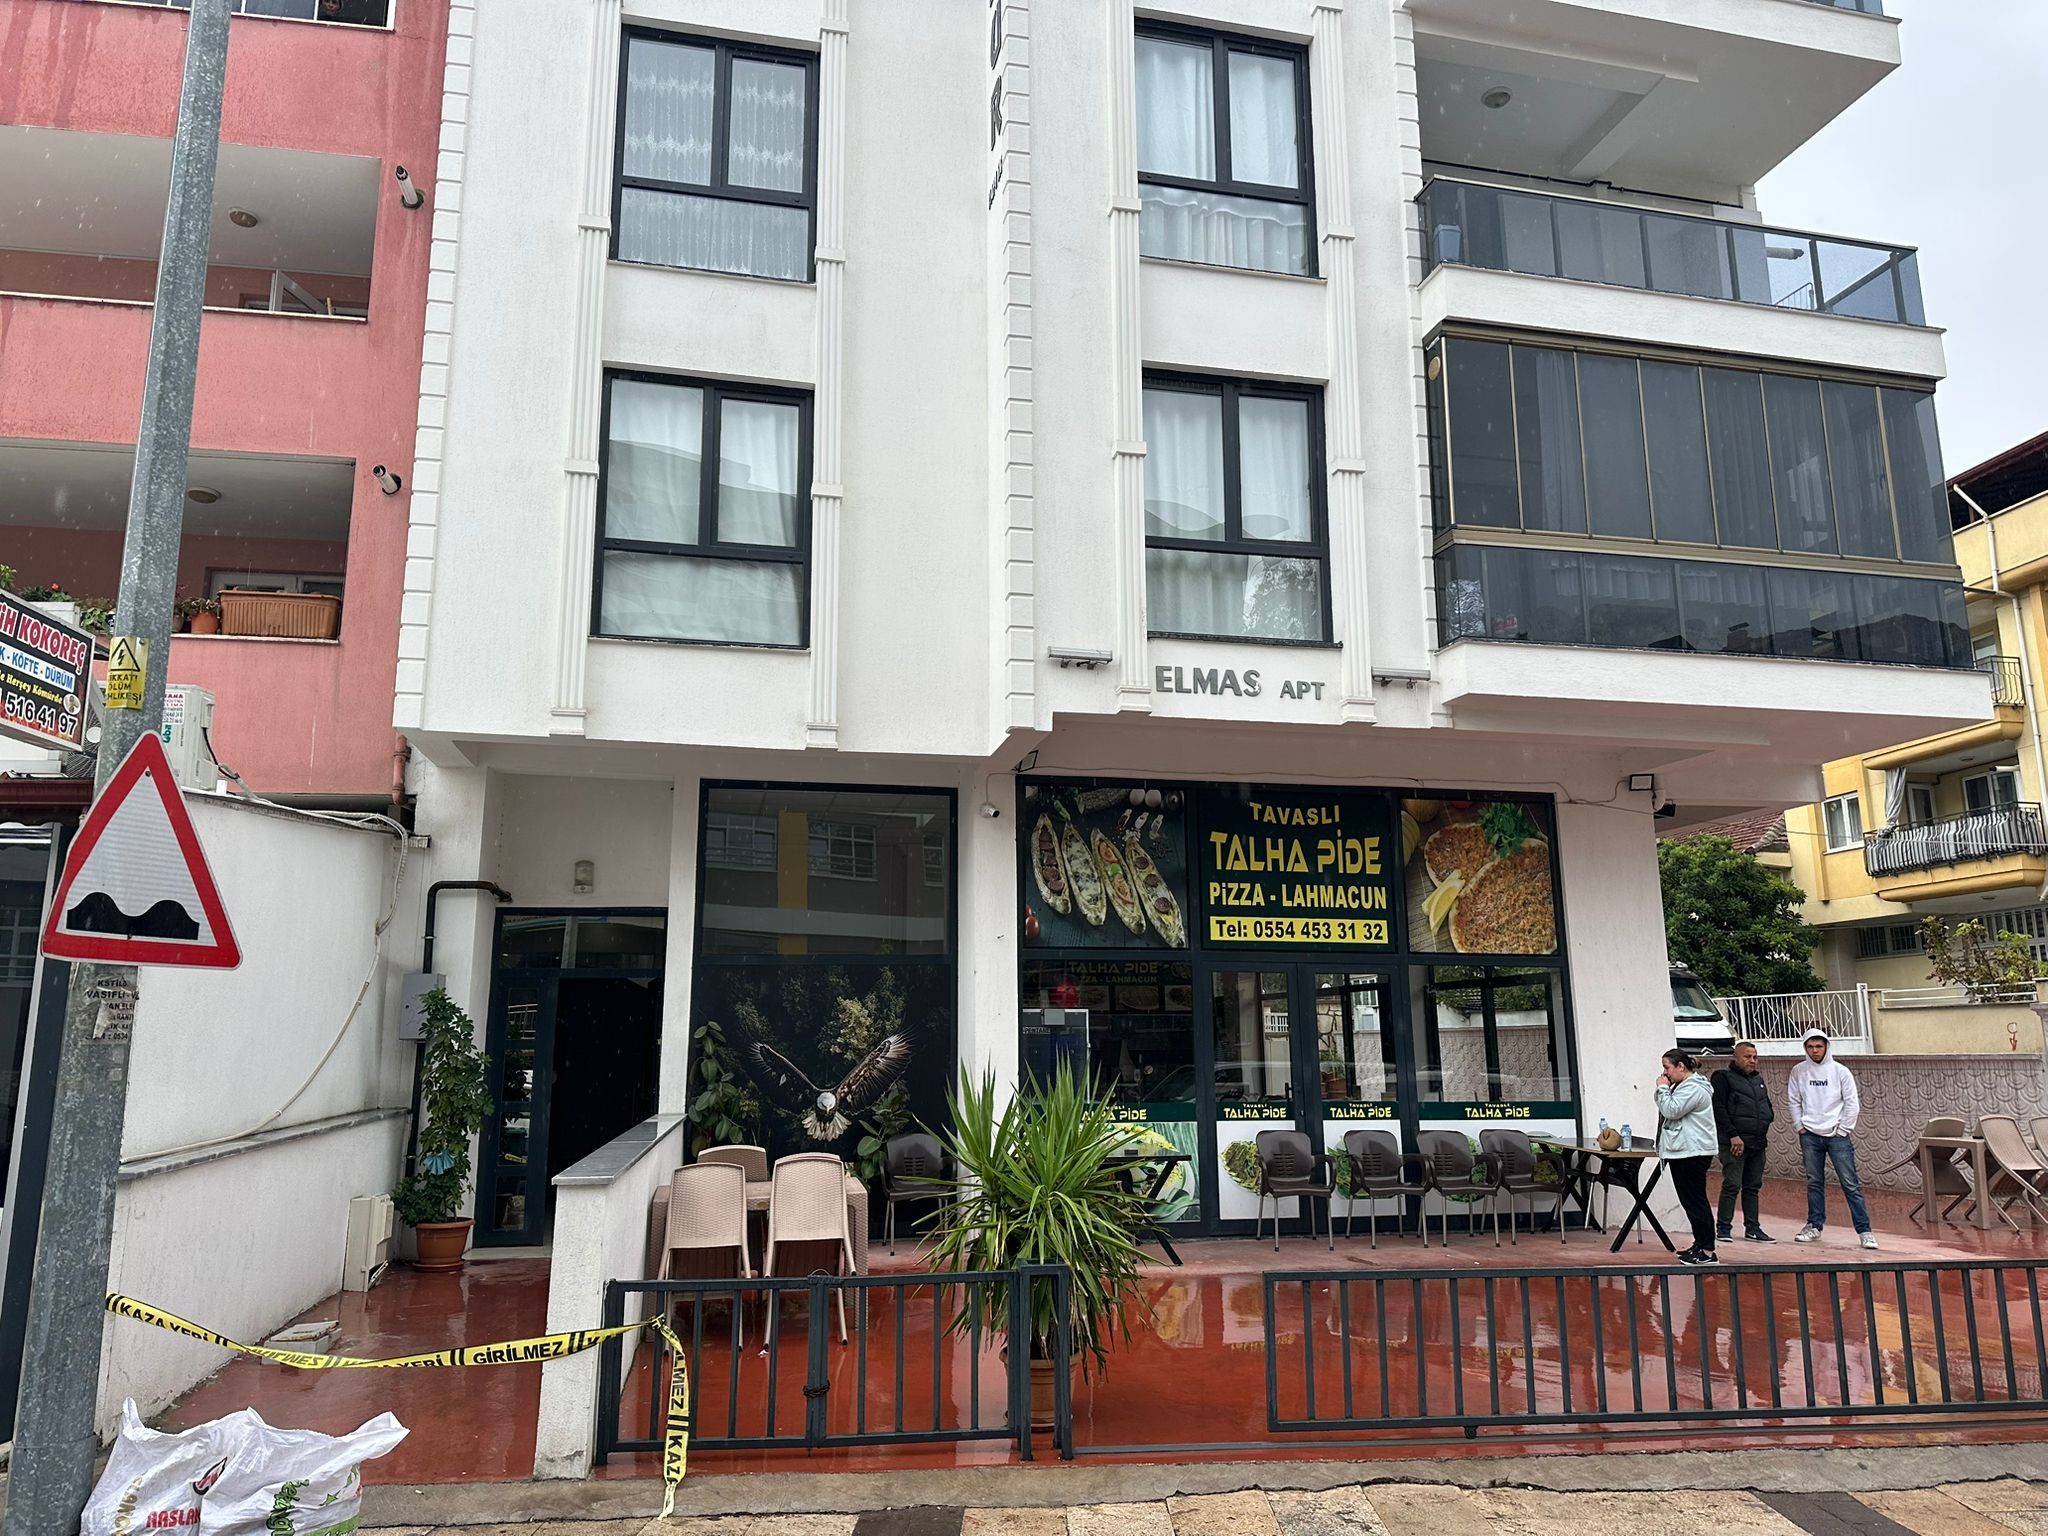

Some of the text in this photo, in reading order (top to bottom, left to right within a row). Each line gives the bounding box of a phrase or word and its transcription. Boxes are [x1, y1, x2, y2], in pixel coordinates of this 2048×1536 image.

[17, 613, 87, 675] KOKOREÇ
[11, 652, 39, 675] KÖFTE
[44, 666, 74, 690] DÜRÜM
[1155, 665, 1326, 700] ELMAS APT
[5, 692, 35, 721] 516
[36, 705, 56, 731] 41
[58, 714, 78, 739] 97
[1250, 801, 1340, 826] TAVASLI
[1209, 829, 1382, 875] TALHA PİDE
[1281, 884, 1387, 909] LAHMACUN
[1216, 920, 1383, 940] Tel: 0554 453 31 32
[1068, 961, 1119, 974] TALHA
[1809, 1078, 1828, 1087] mavi
[1119, 1107, 1147, 1121] PİDE
[1223, 1105, 1287, 1119] TALHA PİDE
[1329, 1105, 1392, 1118] TALHA PİDE
[1464, 1105, 1531, 1118] TALHA PİDE
[120, 1302, 166, 1330] KAZA
[473, 1340, 564, 1365] GİRİLMEZ
